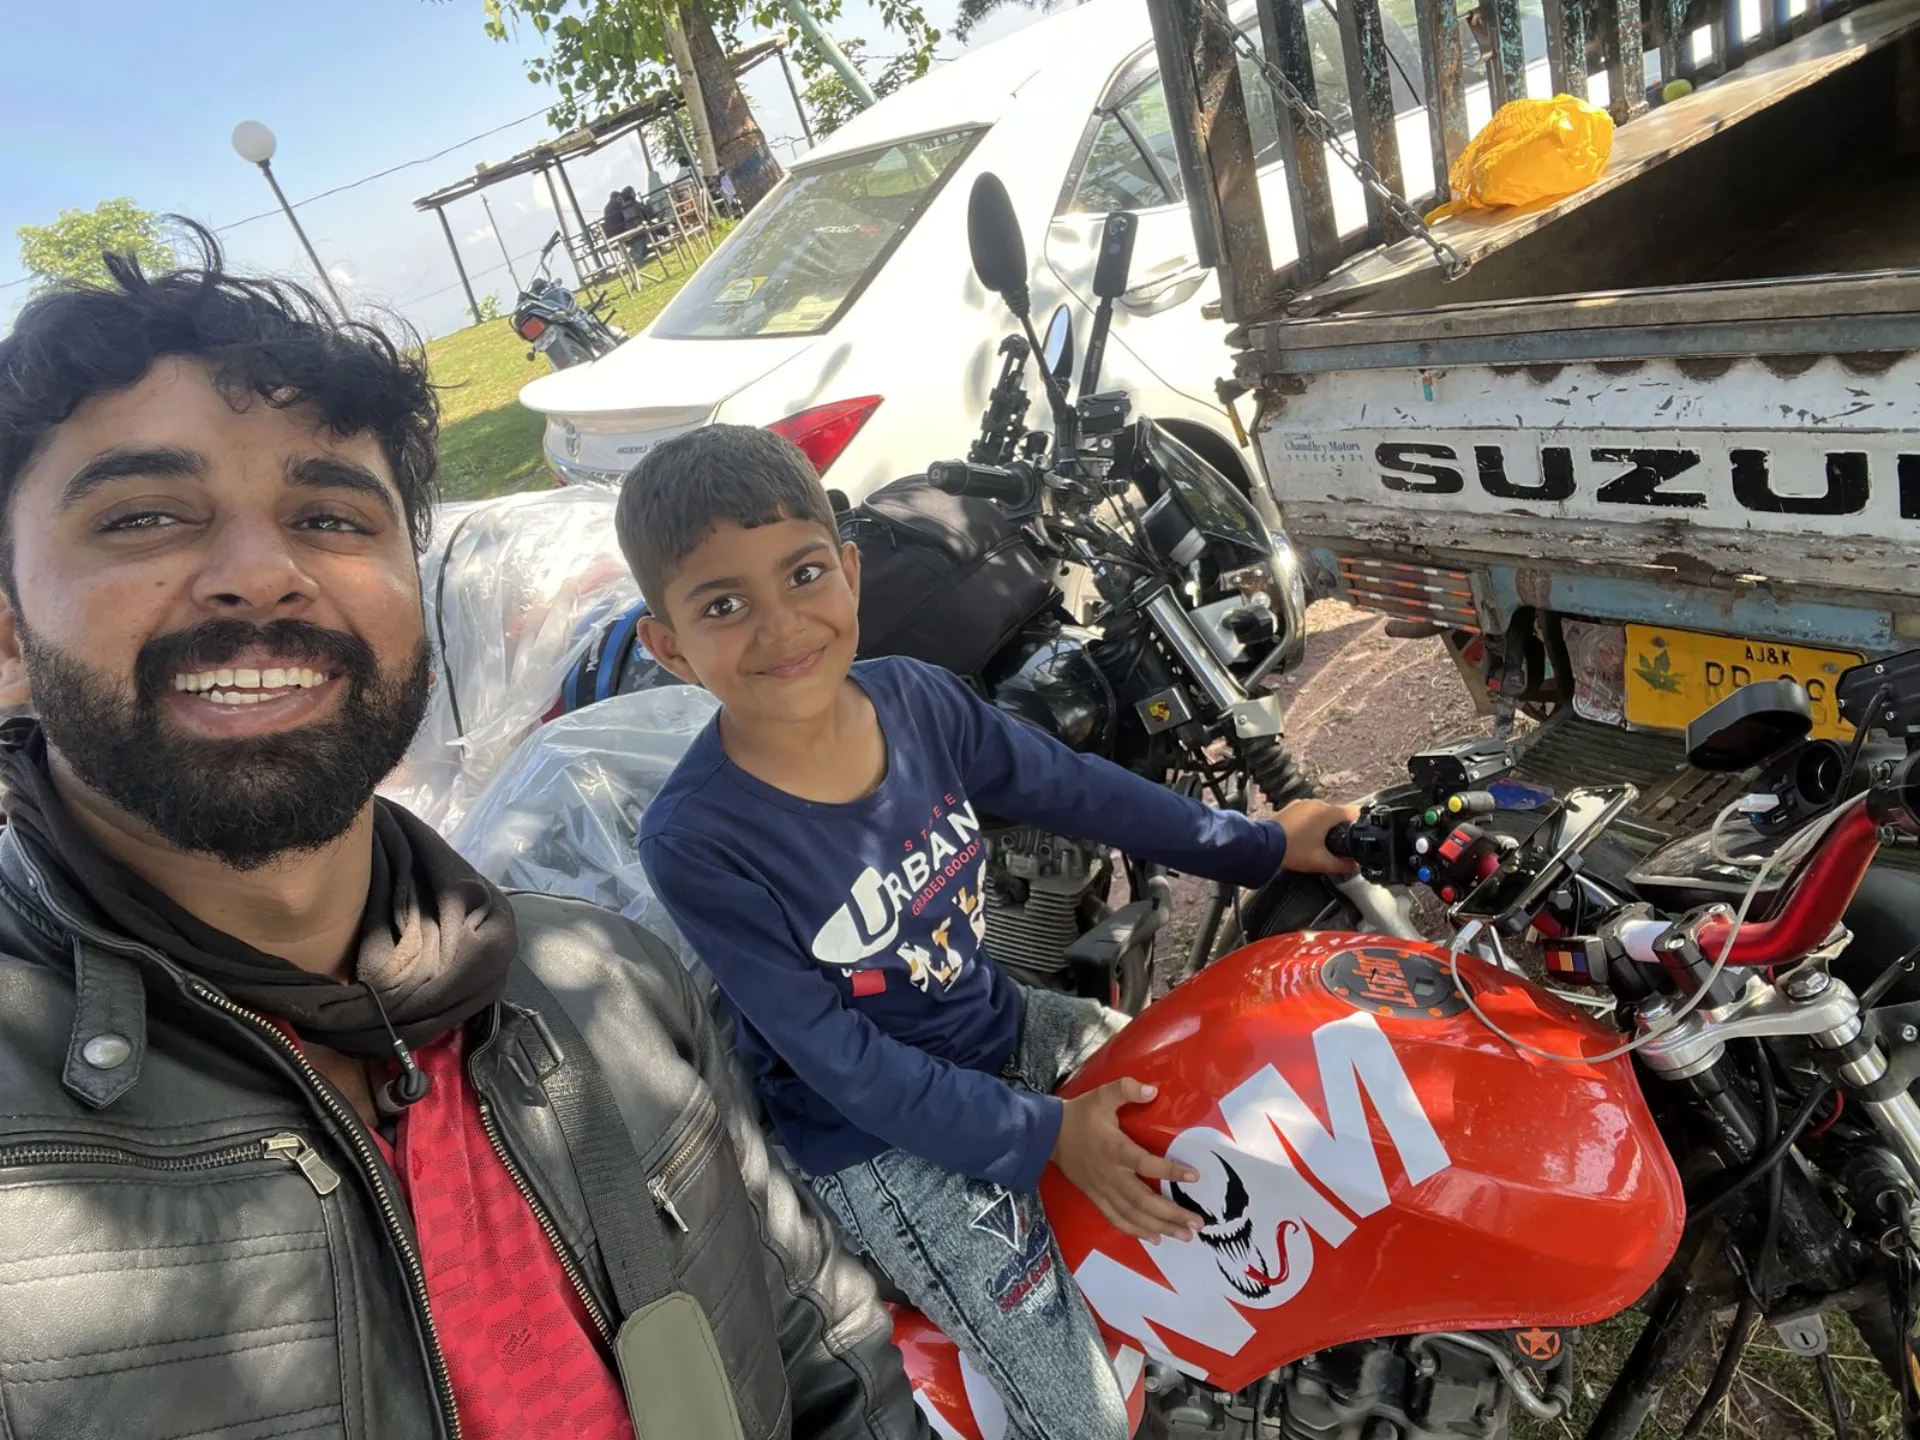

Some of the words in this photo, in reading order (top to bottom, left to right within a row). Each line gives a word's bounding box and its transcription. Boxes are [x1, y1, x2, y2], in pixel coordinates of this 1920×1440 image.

[1329, 440, 1360, 451] Motors
[1745, 645, 1792, 666] AJ&K
[812, 800, 979, 963] URBAN
[912, 875, 946, 916] GRADED
[944, 837, 981, 877] GOODS
